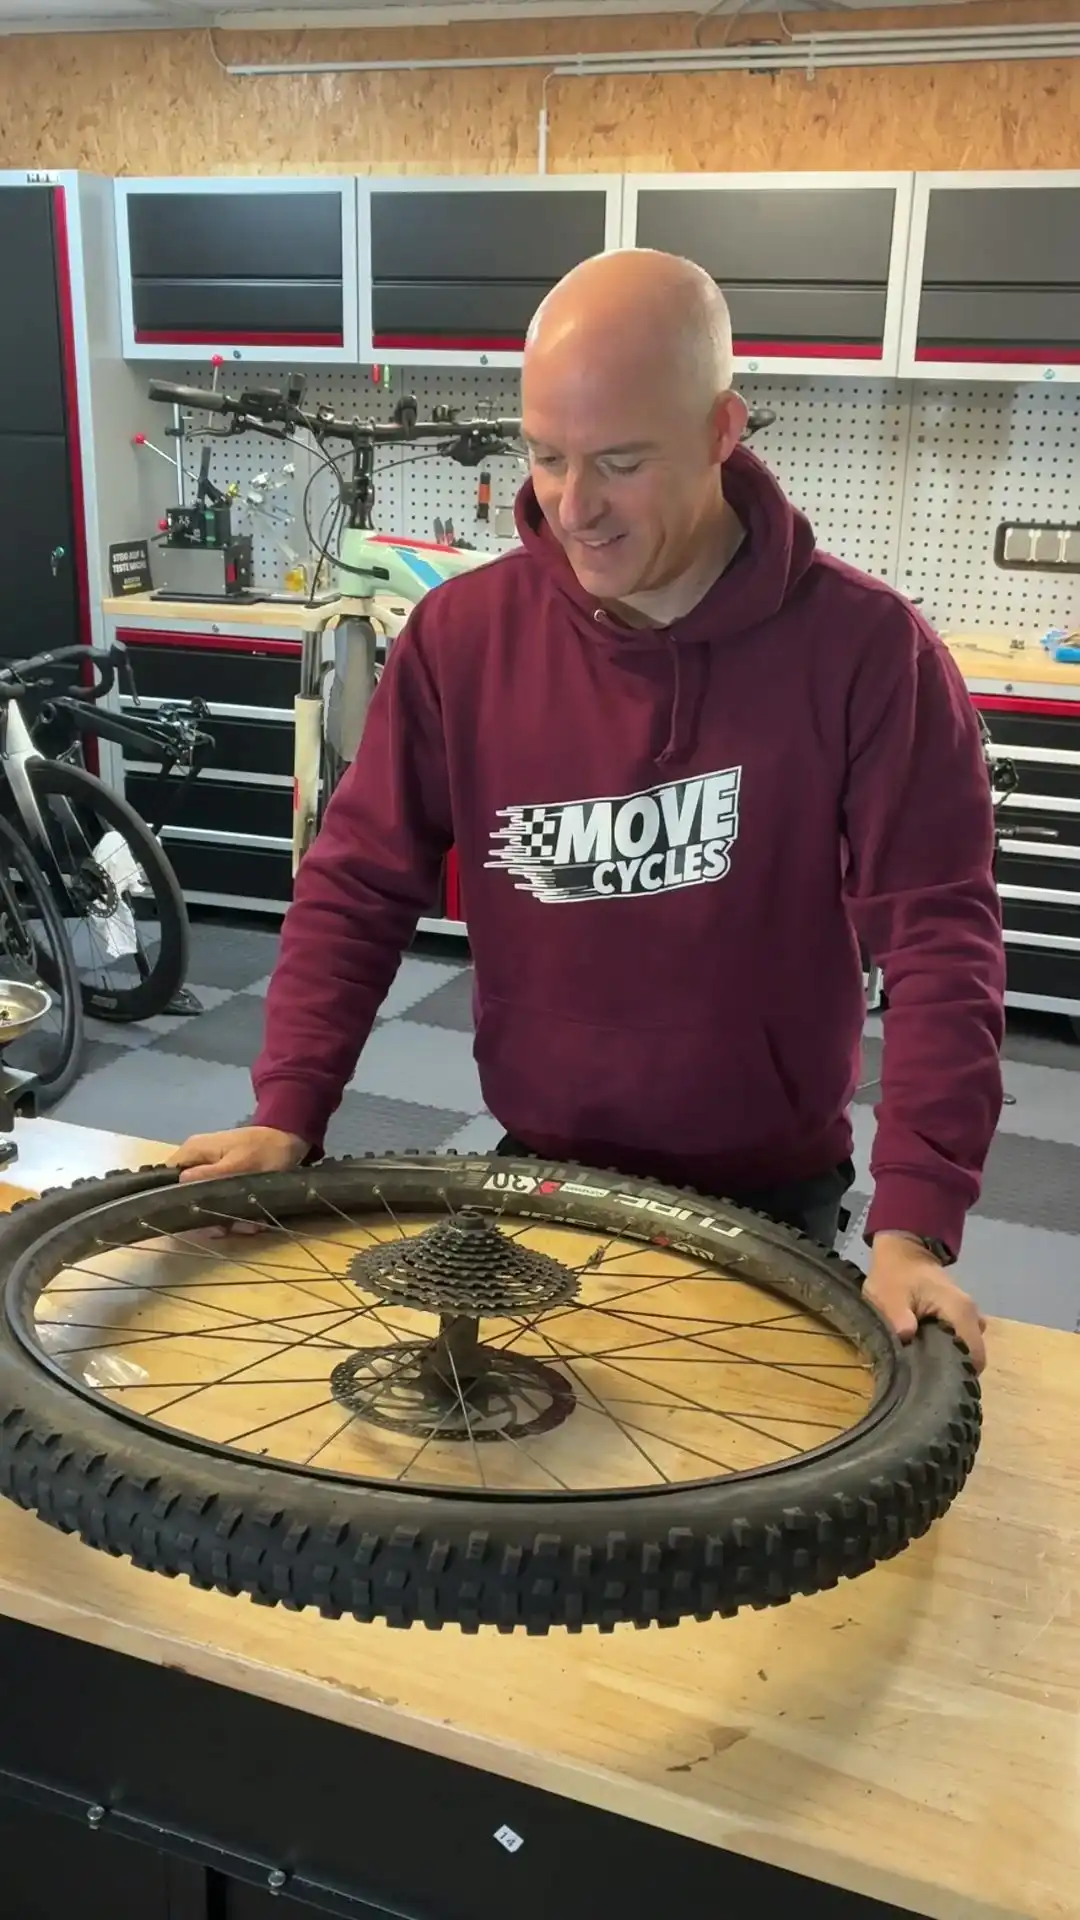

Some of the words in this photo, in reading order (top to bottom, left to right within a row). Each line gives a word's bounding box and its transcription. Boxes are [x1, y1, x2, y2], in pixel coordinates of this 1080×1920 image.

[554, 772, 736, 864] MOVE
[592, 840, 727, 894] CYCLES
[500, 1832, 516, 1847] 14
